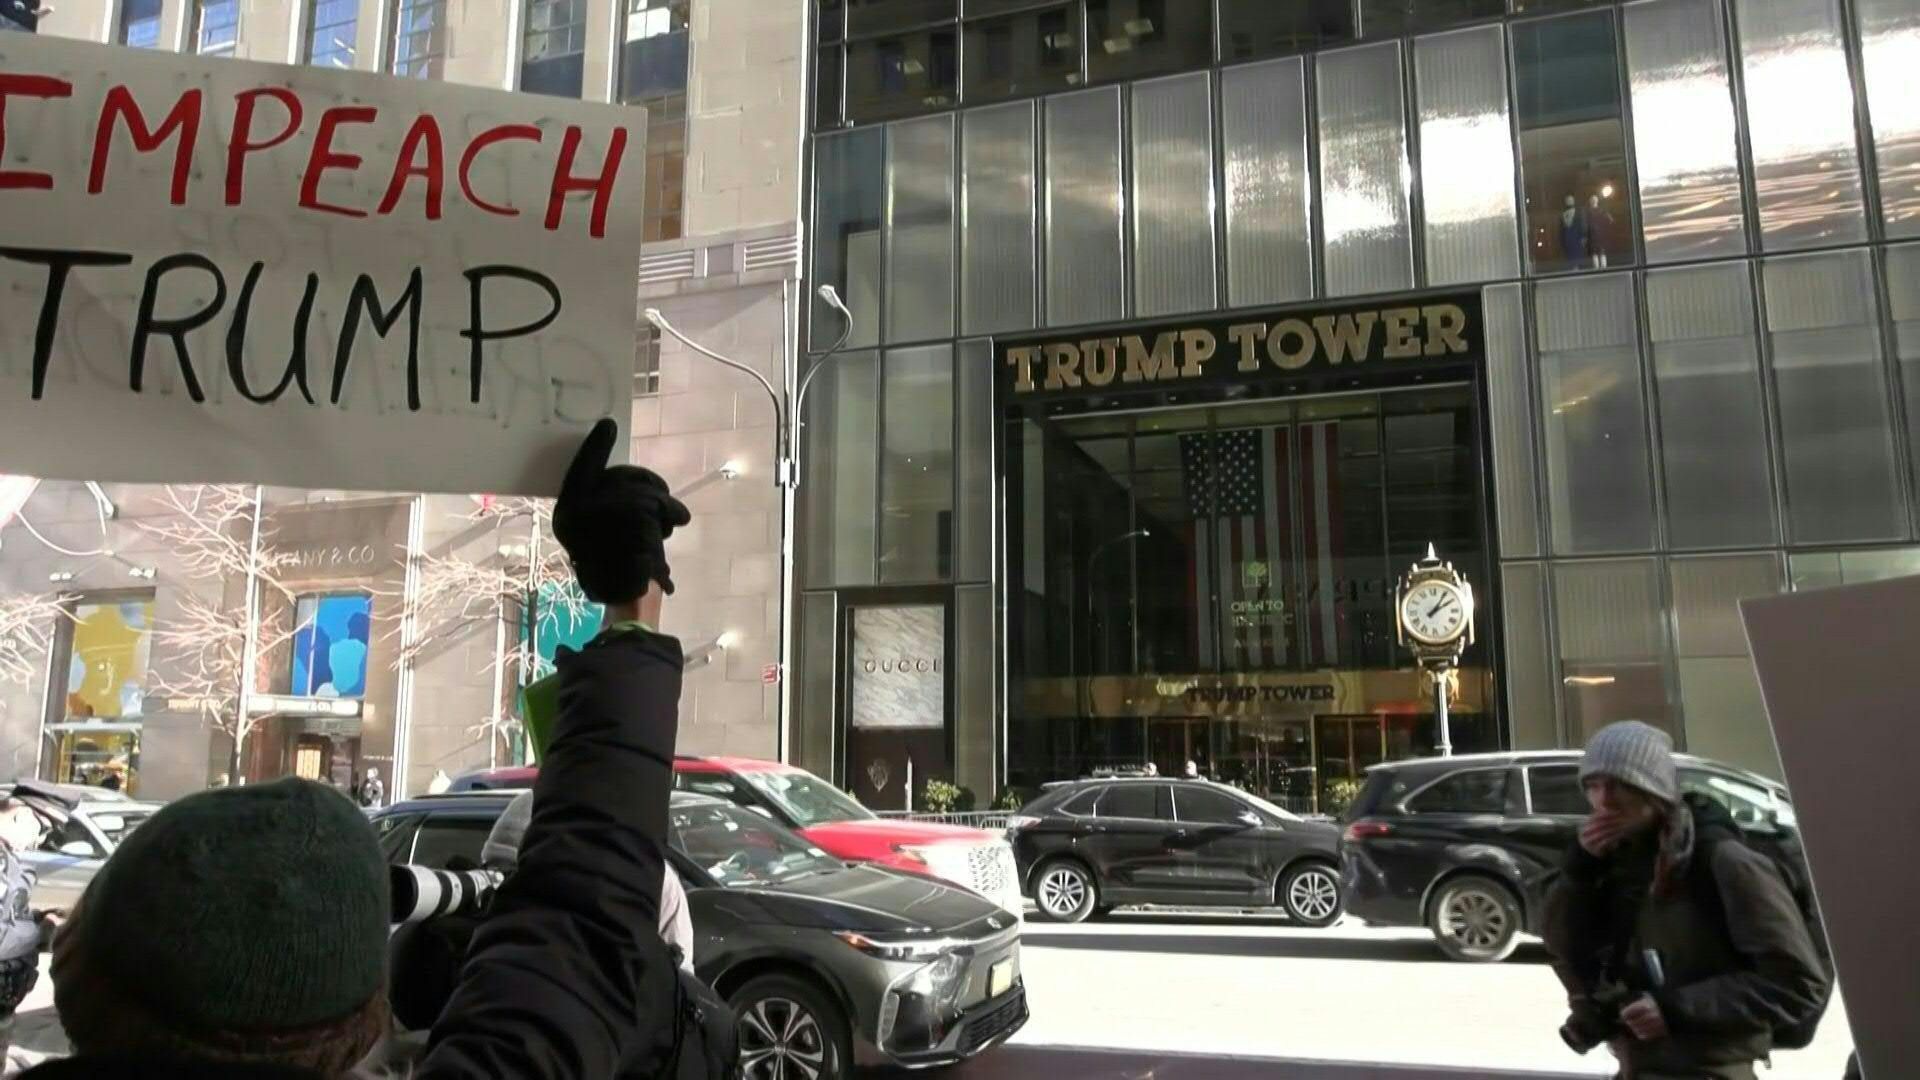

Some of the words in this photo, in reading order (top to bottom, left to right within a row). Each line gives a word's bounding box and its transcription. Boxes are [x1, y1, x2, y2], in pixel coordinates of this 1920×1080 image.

[0, 75, 627, 238] IMPEACH
[0, 246, 562, 411] TRUMP
[1006, 328, 1217, 394] TRUMP
[1228, 303, 1468, 371] TOWER
[864, 658, 937, 674] GUCCI
[1188, 687, 1257, 703] TRUMP
[1259, 684, 1335, 700] TOWER
